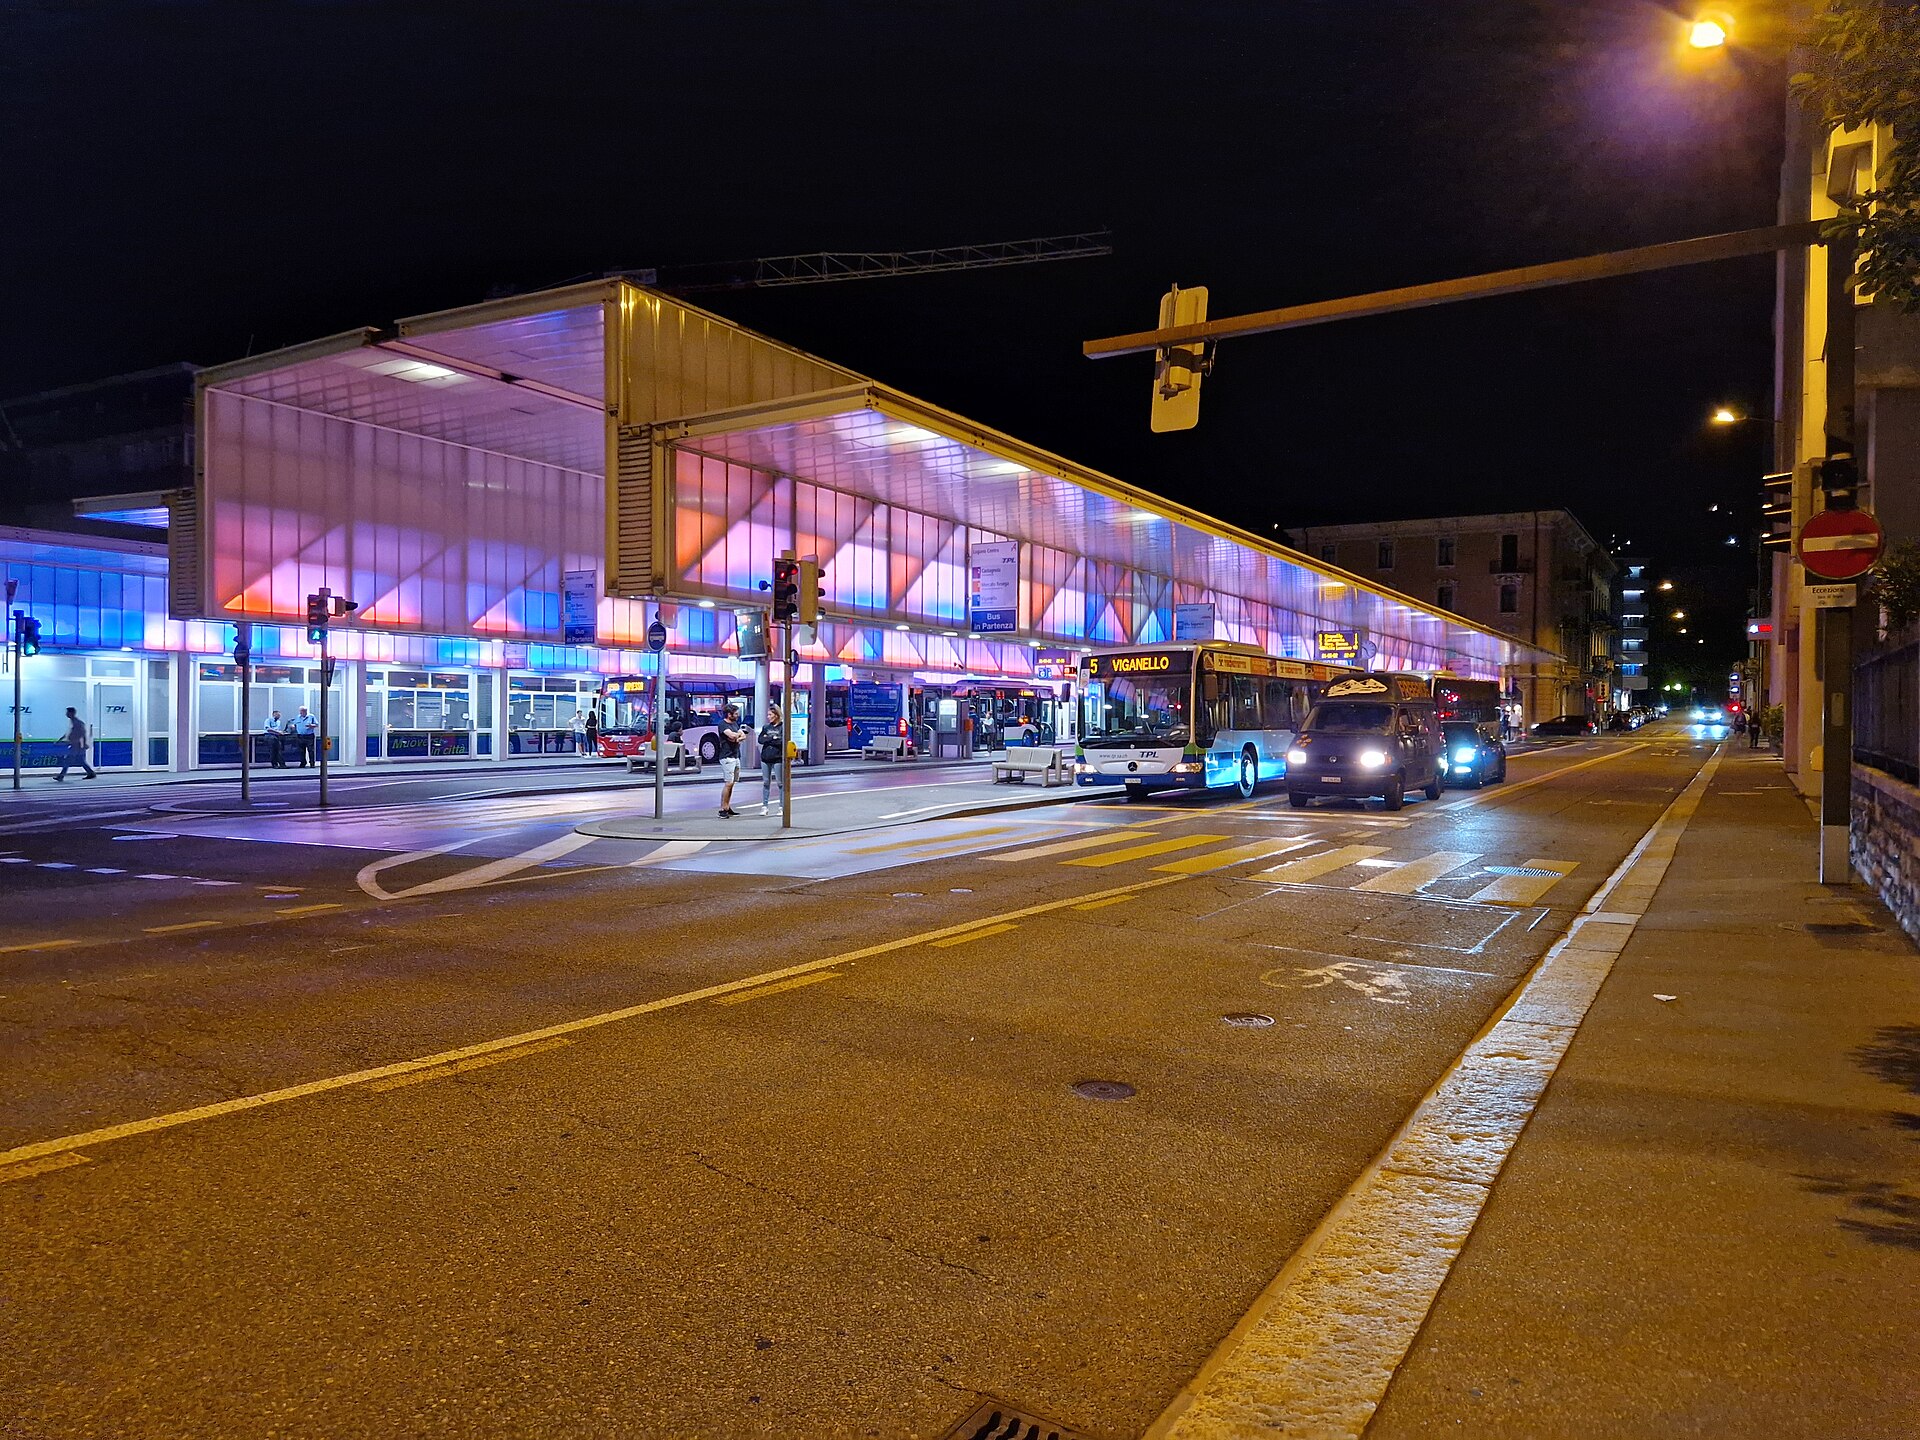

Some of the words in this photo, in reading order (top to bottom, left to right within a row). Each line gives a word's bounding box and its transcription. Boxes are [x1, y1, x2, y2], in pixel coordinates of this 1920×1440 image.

[982, 622, 1014, 630] Partenza
[1090, 658, 1098, 674] 5
[1112, 656, 1170, 672] VIGANELLO
[9, 705, 32, 714] TPL
[106, 705, 127, 713] TPL
[431, 746, 440, 756] in
[1140, 751, 1159, 759] TPL
